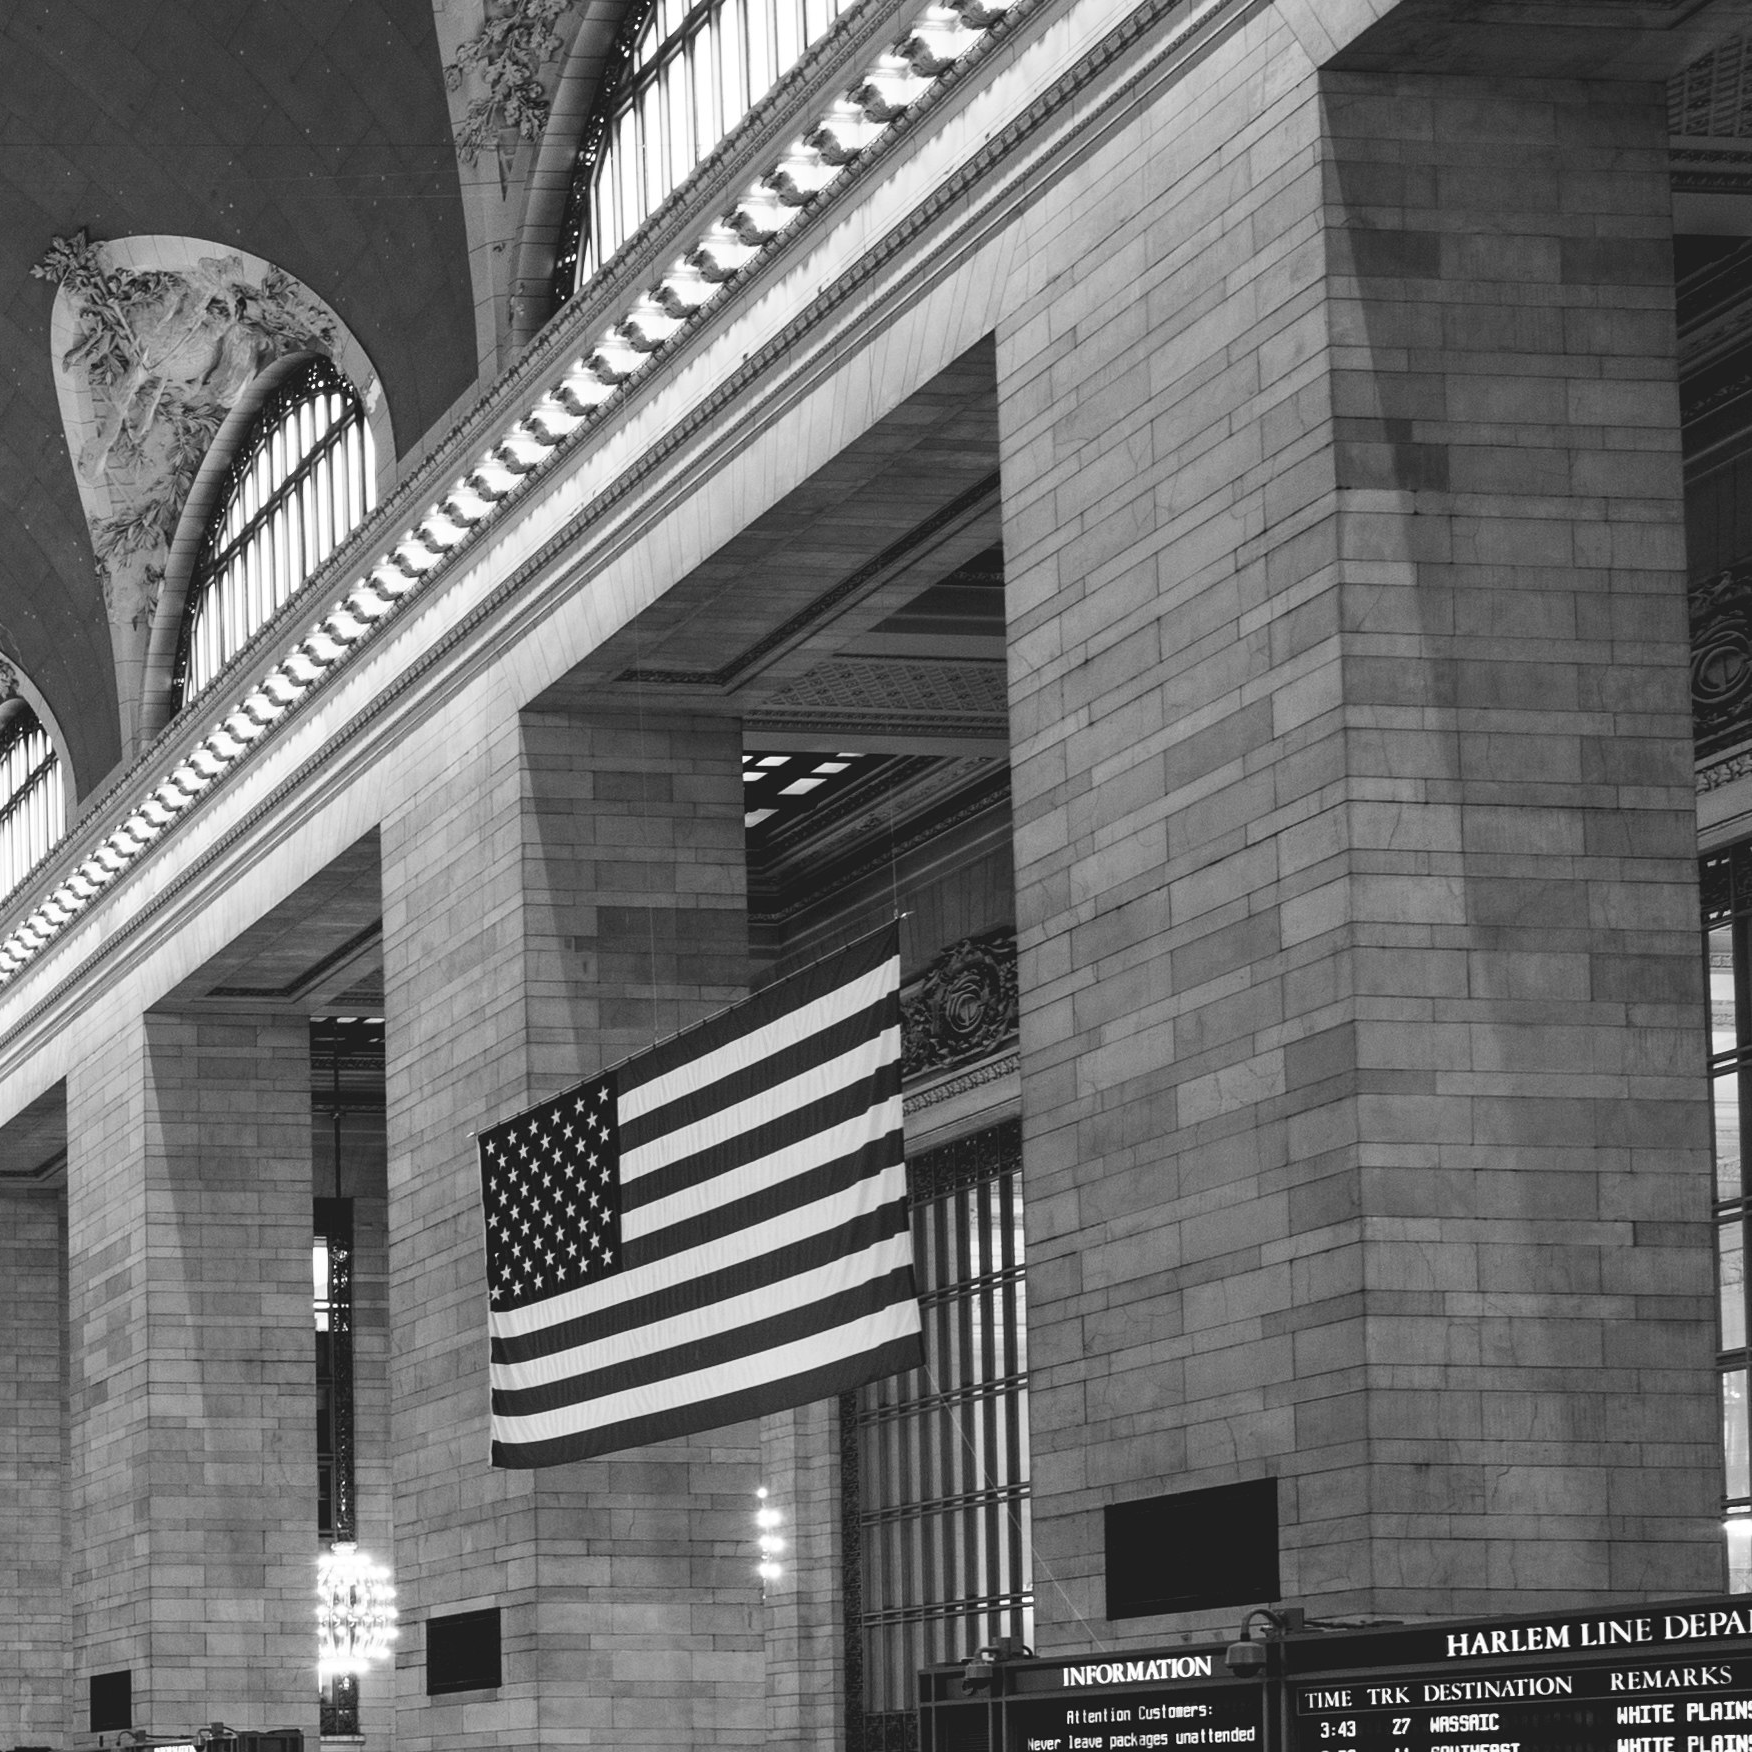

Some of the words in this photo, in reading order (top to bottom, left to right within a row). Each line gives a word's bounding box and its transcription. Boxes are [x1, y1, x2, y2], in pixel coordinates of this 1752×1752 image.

[1446, 1625, 1570, 1657] HARLEM
[1580, 1618, 1653, 1647] LINE
[1662, 1609, 1752, 1640] DEPA
[1063, 1656, 1213, 1686] INFORMATION
[1305, 1691, 1352, 1709] TIME
[1367, 1687, 1410, 1705] TRK
[1424, 1677, 1573, 1702] DESTINATION
[1610, 1665, 1732, 1691] REMARKS
[1067, 1707, 1131, 1724] Attention
[1138, 1704, 1213, 1720] Customers:
[1320, 1720, 1356, 1738] 3:43
[1392, 1718, 1411, 1735] 27
[1430, 1713, 1499, 1733] WASSAIC
[1617, 1704, 1675, 1724] WHITE
[1027, 1737, 1061, 1751] Never
[1069, 1735, 1103, 1750] leave
[1109, 1732, 1168, 1749] packages
[1176, 1726, 1255, 1744] unattended
